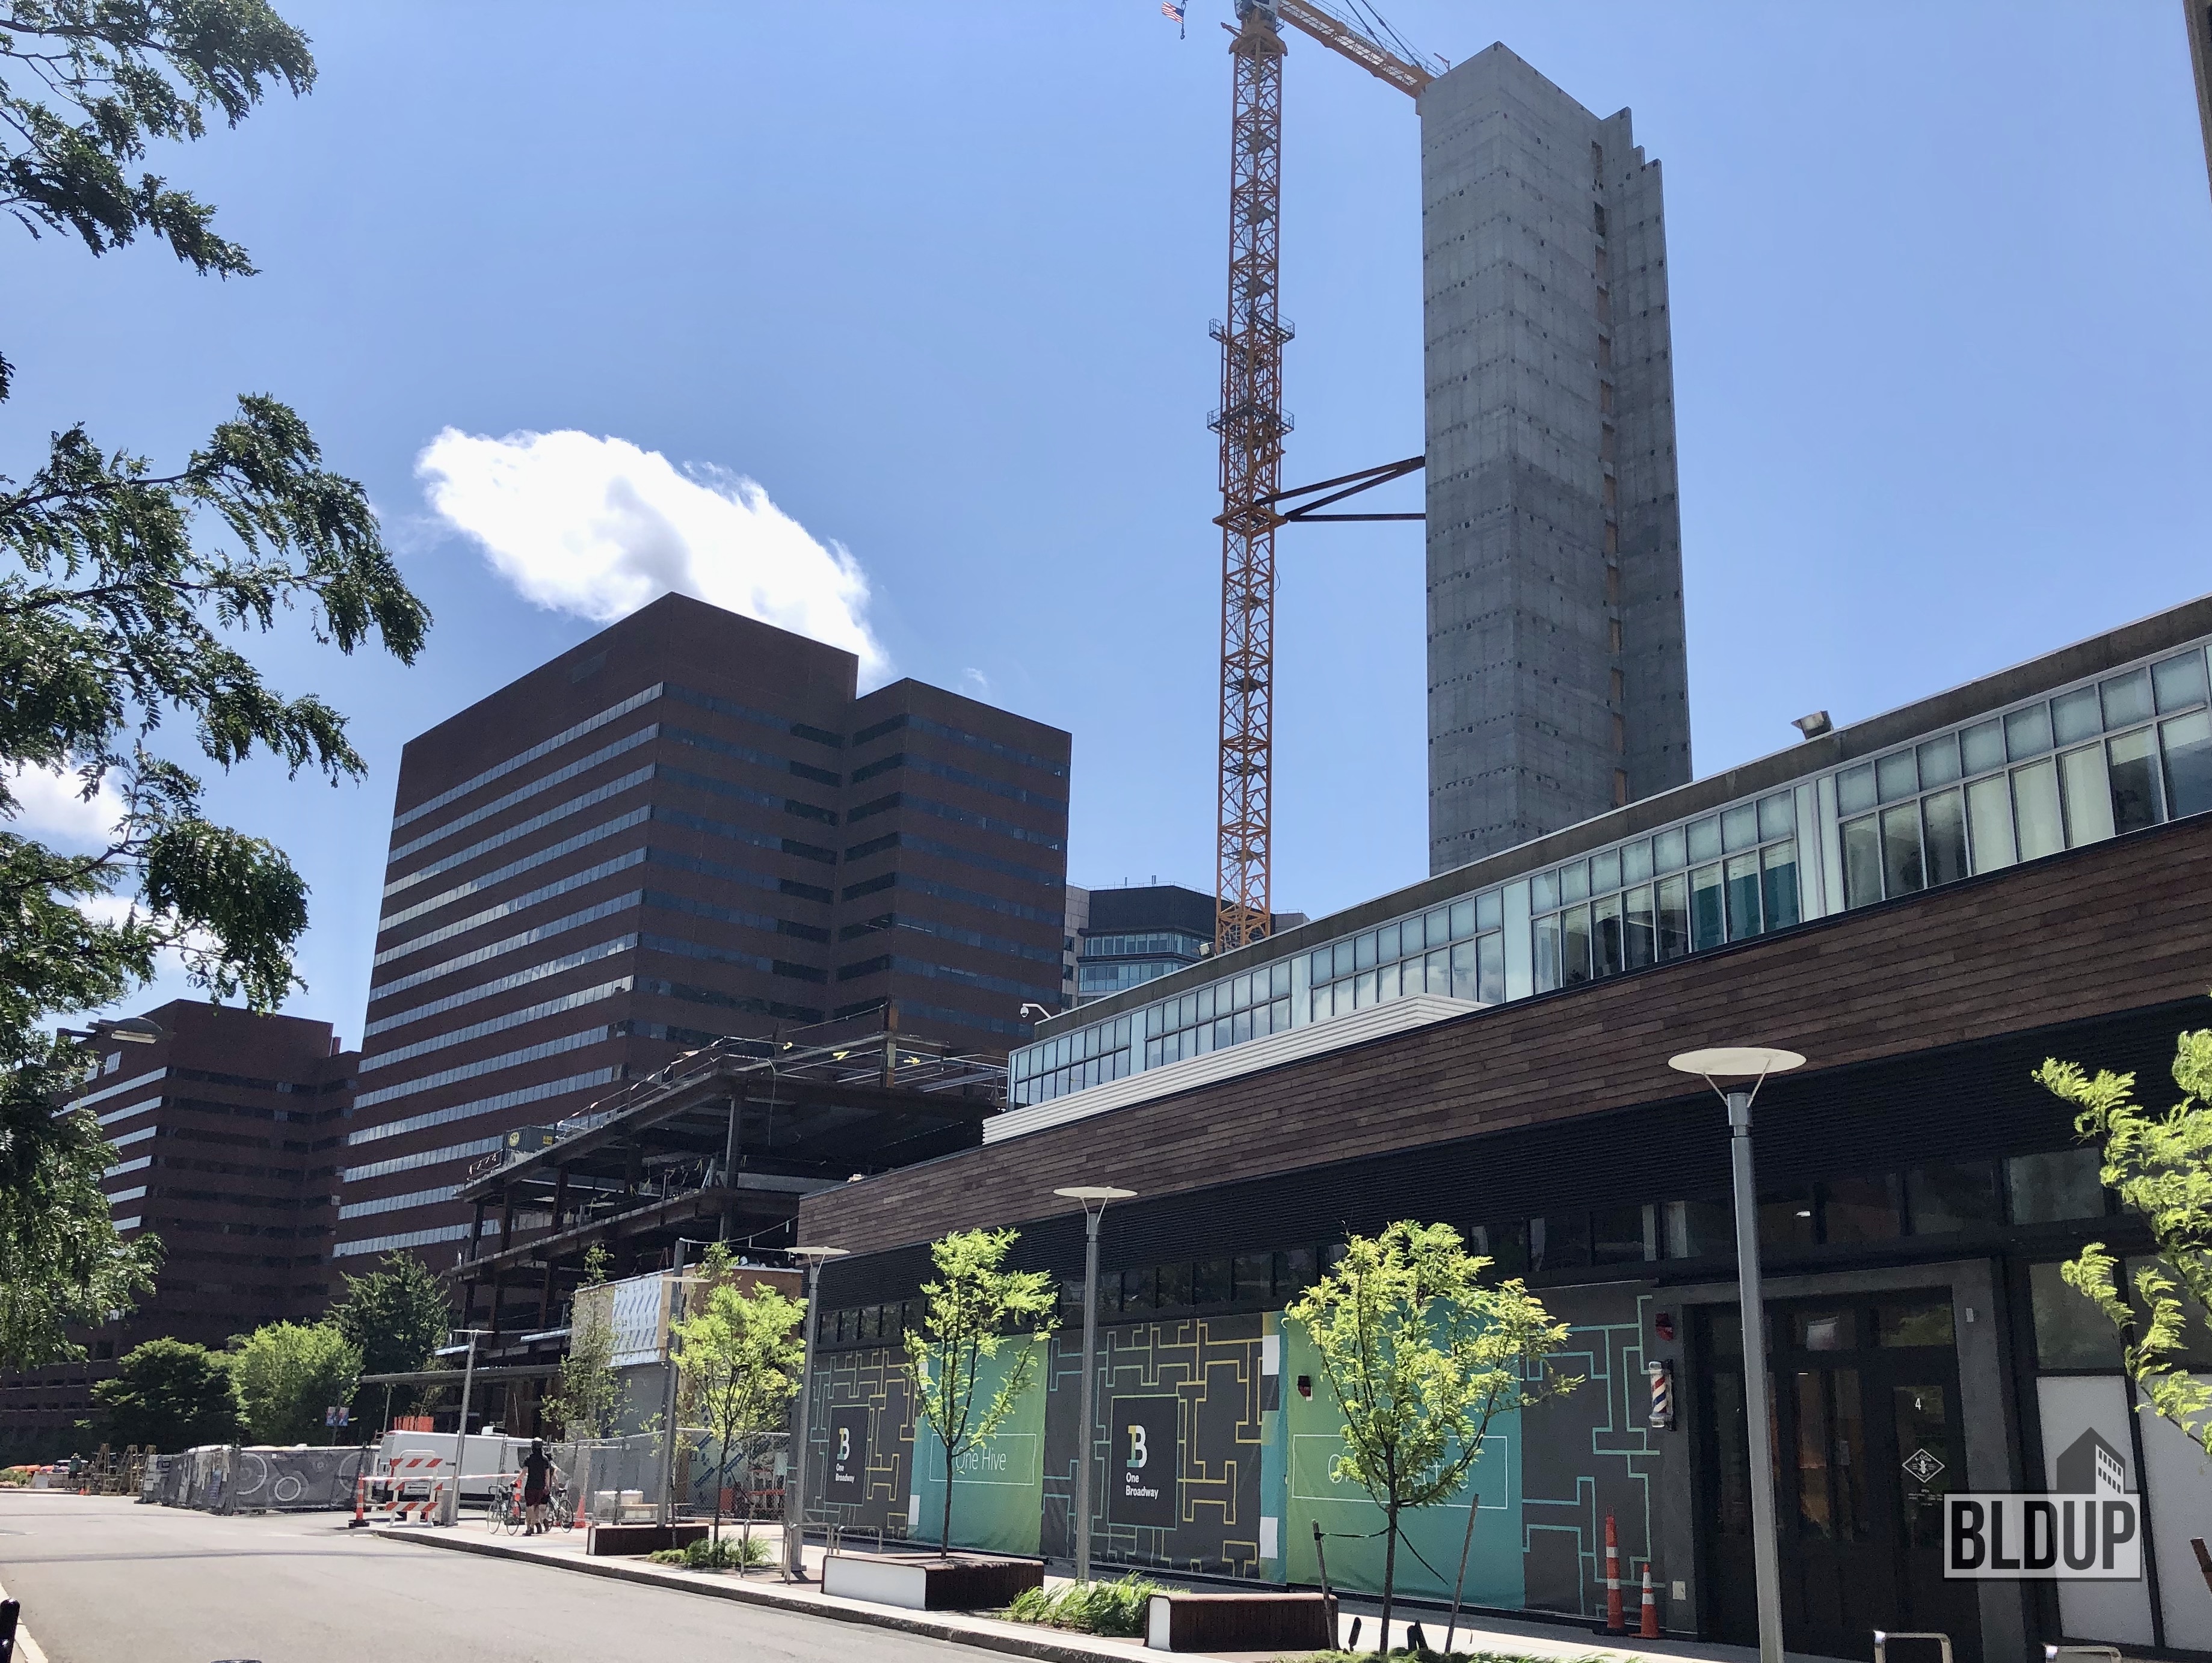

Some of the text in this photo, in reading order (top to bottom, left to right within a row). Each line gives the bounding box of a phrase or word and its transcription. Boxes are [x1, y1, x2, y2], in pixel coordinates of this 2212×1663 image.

[1915, 1398, 1921, 1410] 4
[955, 1446, 1006, 1471] One Hive
[1126, 1472, 1139, 1483] One
[1126, 1484, 1159, 1500] Broadway
